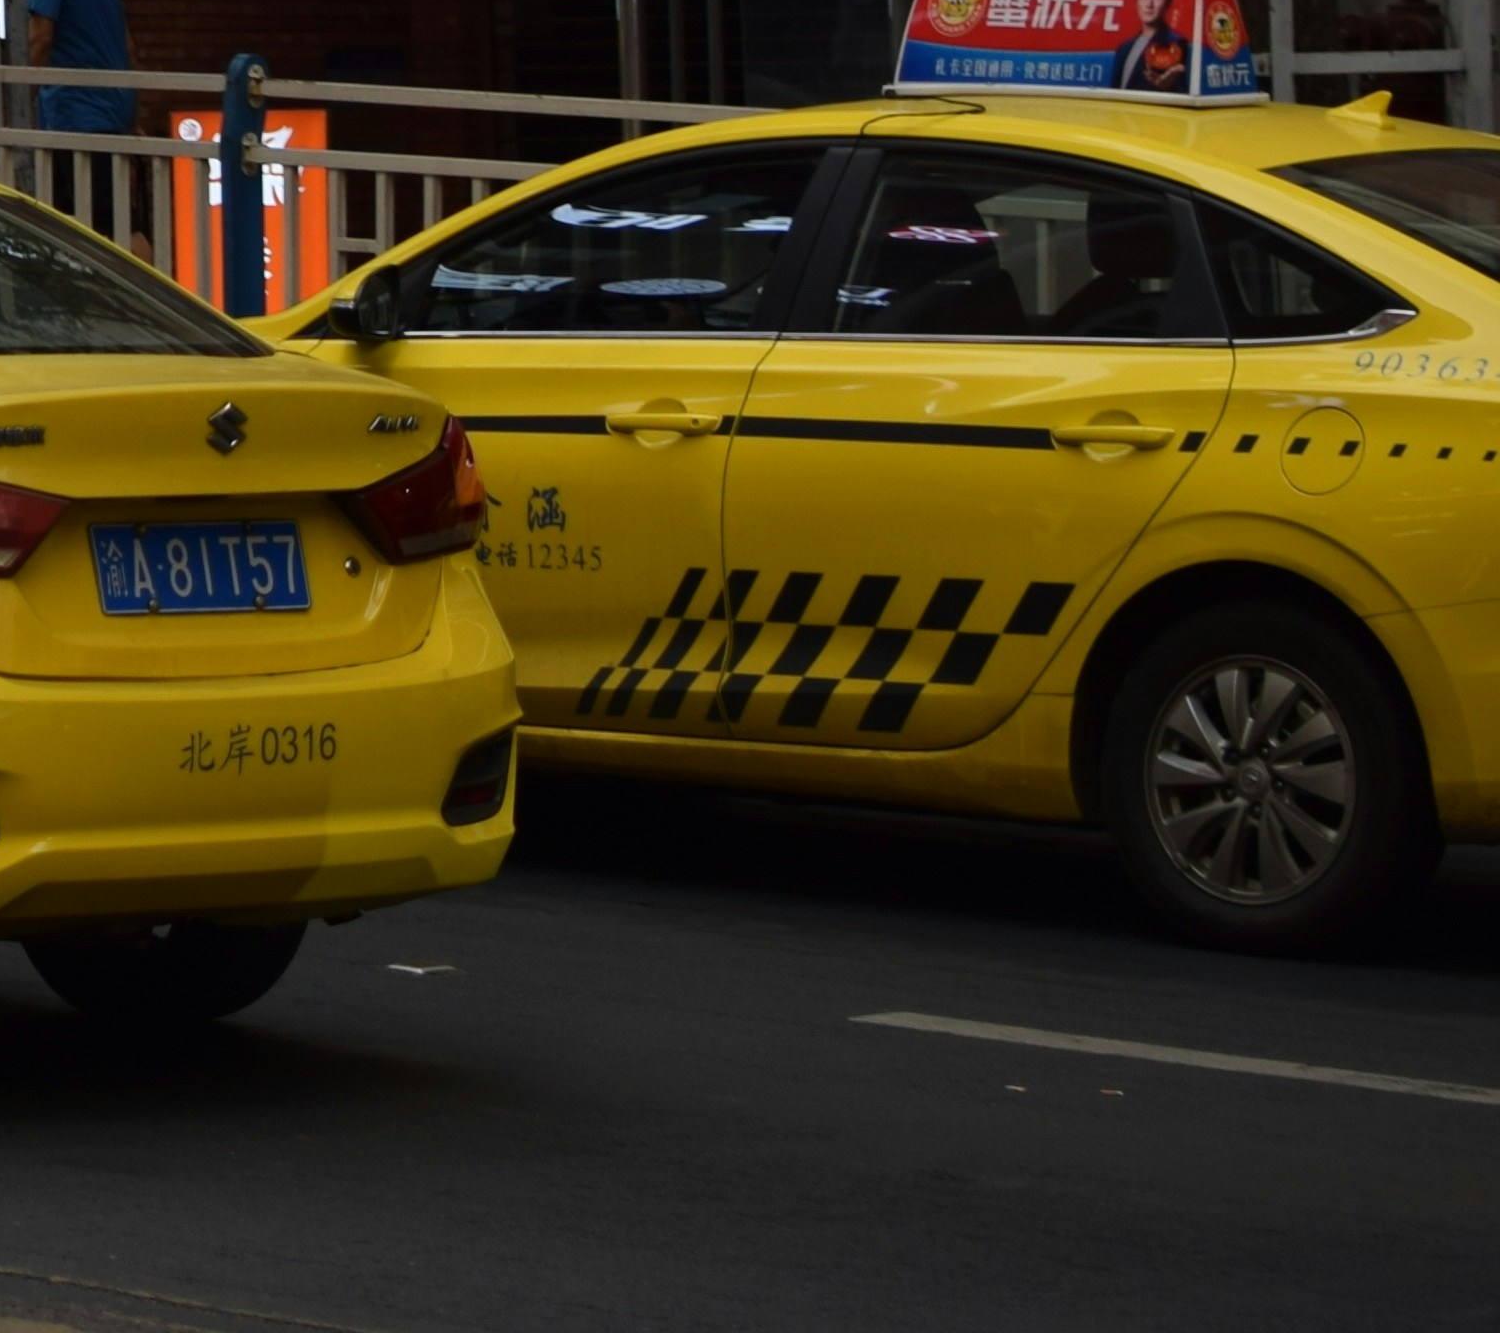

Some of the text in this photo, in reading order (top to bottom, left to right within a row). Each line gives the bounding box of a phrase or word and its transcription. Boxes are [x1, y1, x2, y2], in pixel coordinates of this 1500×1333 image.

[1355, 350, 1500, 382] 90363
[100, 534, 298, 599] 渝A·81T57
[179, 721, 339, 776] 北岸0316
